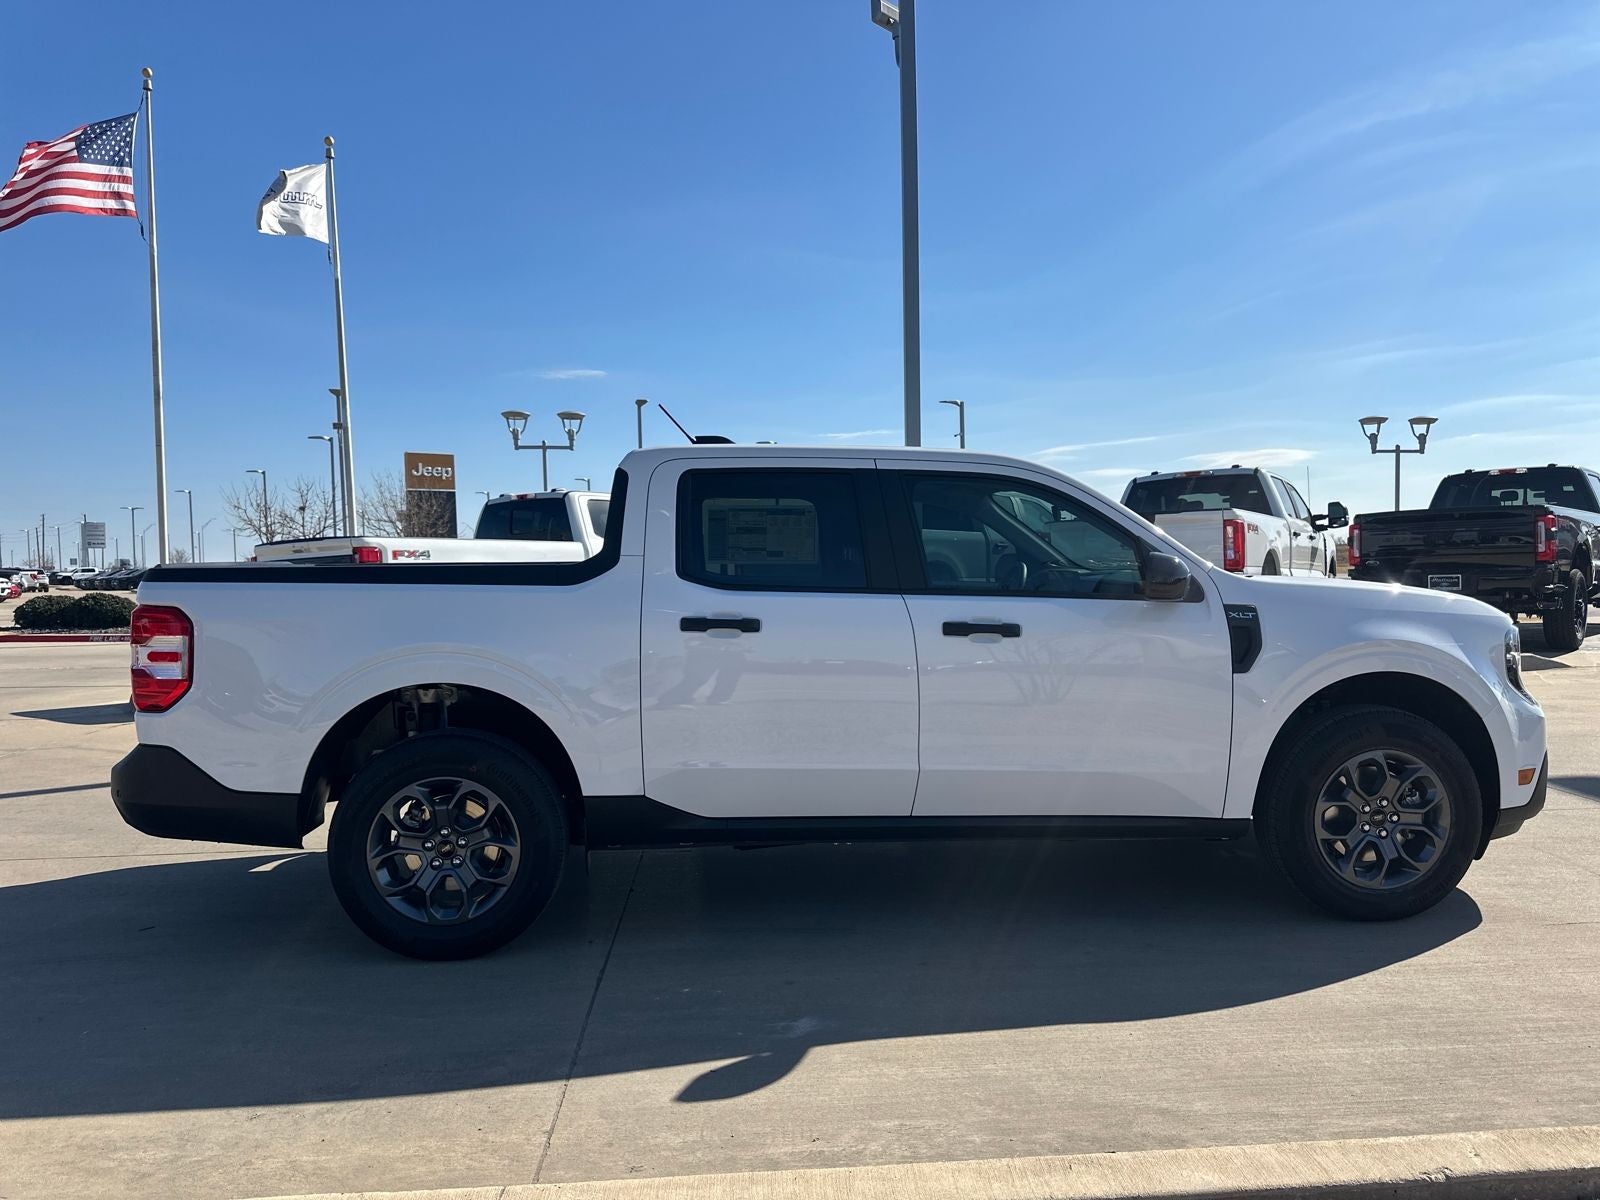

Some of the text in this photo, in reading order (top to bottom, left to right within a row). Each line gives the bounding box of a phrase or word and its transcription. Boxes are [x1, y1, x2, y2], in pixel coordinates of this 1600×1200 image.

[411, 462, 453, 480] Jeep
[391, 549, 431, 561] FX4
[1228, 611, 1257, 619] XLT
